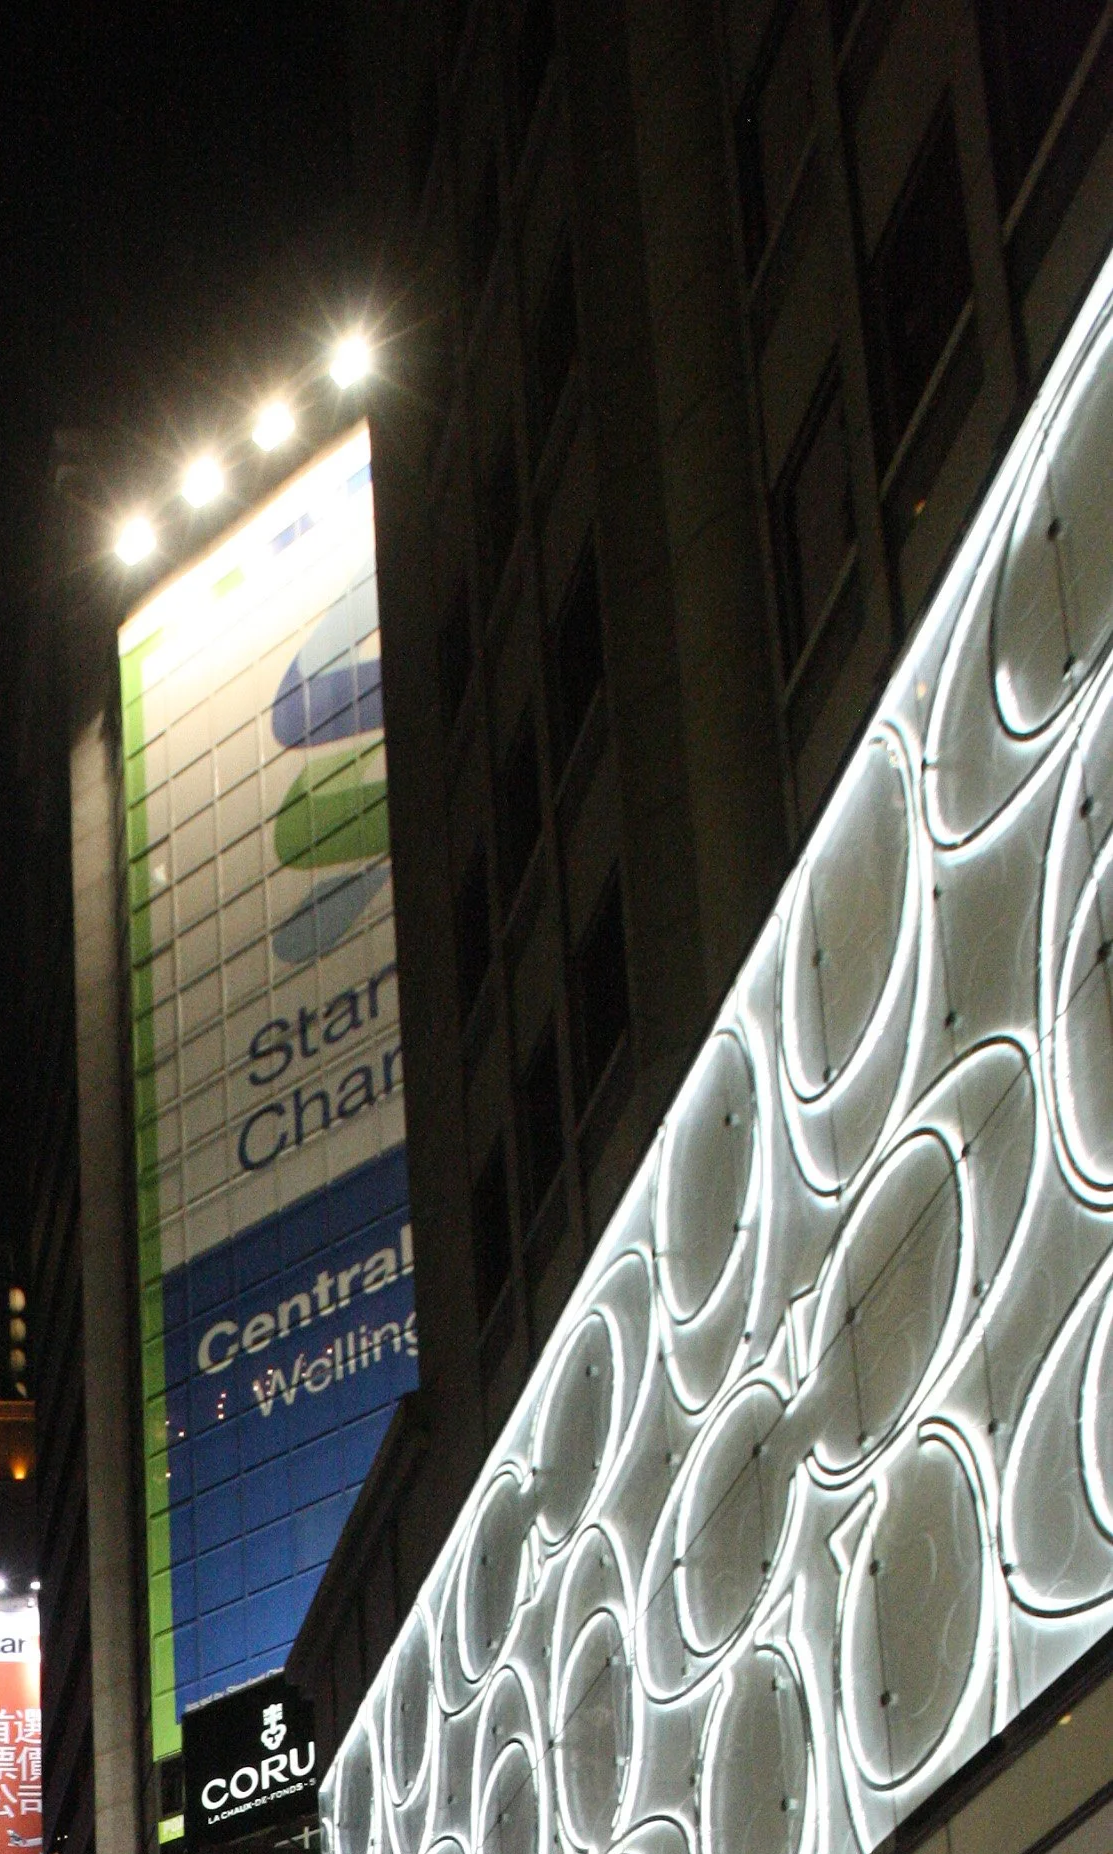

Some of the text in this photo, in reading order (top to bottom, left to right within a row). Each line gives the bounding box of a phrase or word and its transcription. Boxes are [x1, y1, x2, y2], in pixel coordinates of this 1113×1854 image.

[197, 1223, 415, 1375] Central
[201, 1741, 316, 1811] CORU
[207, 1813, 220, 1825] LA
